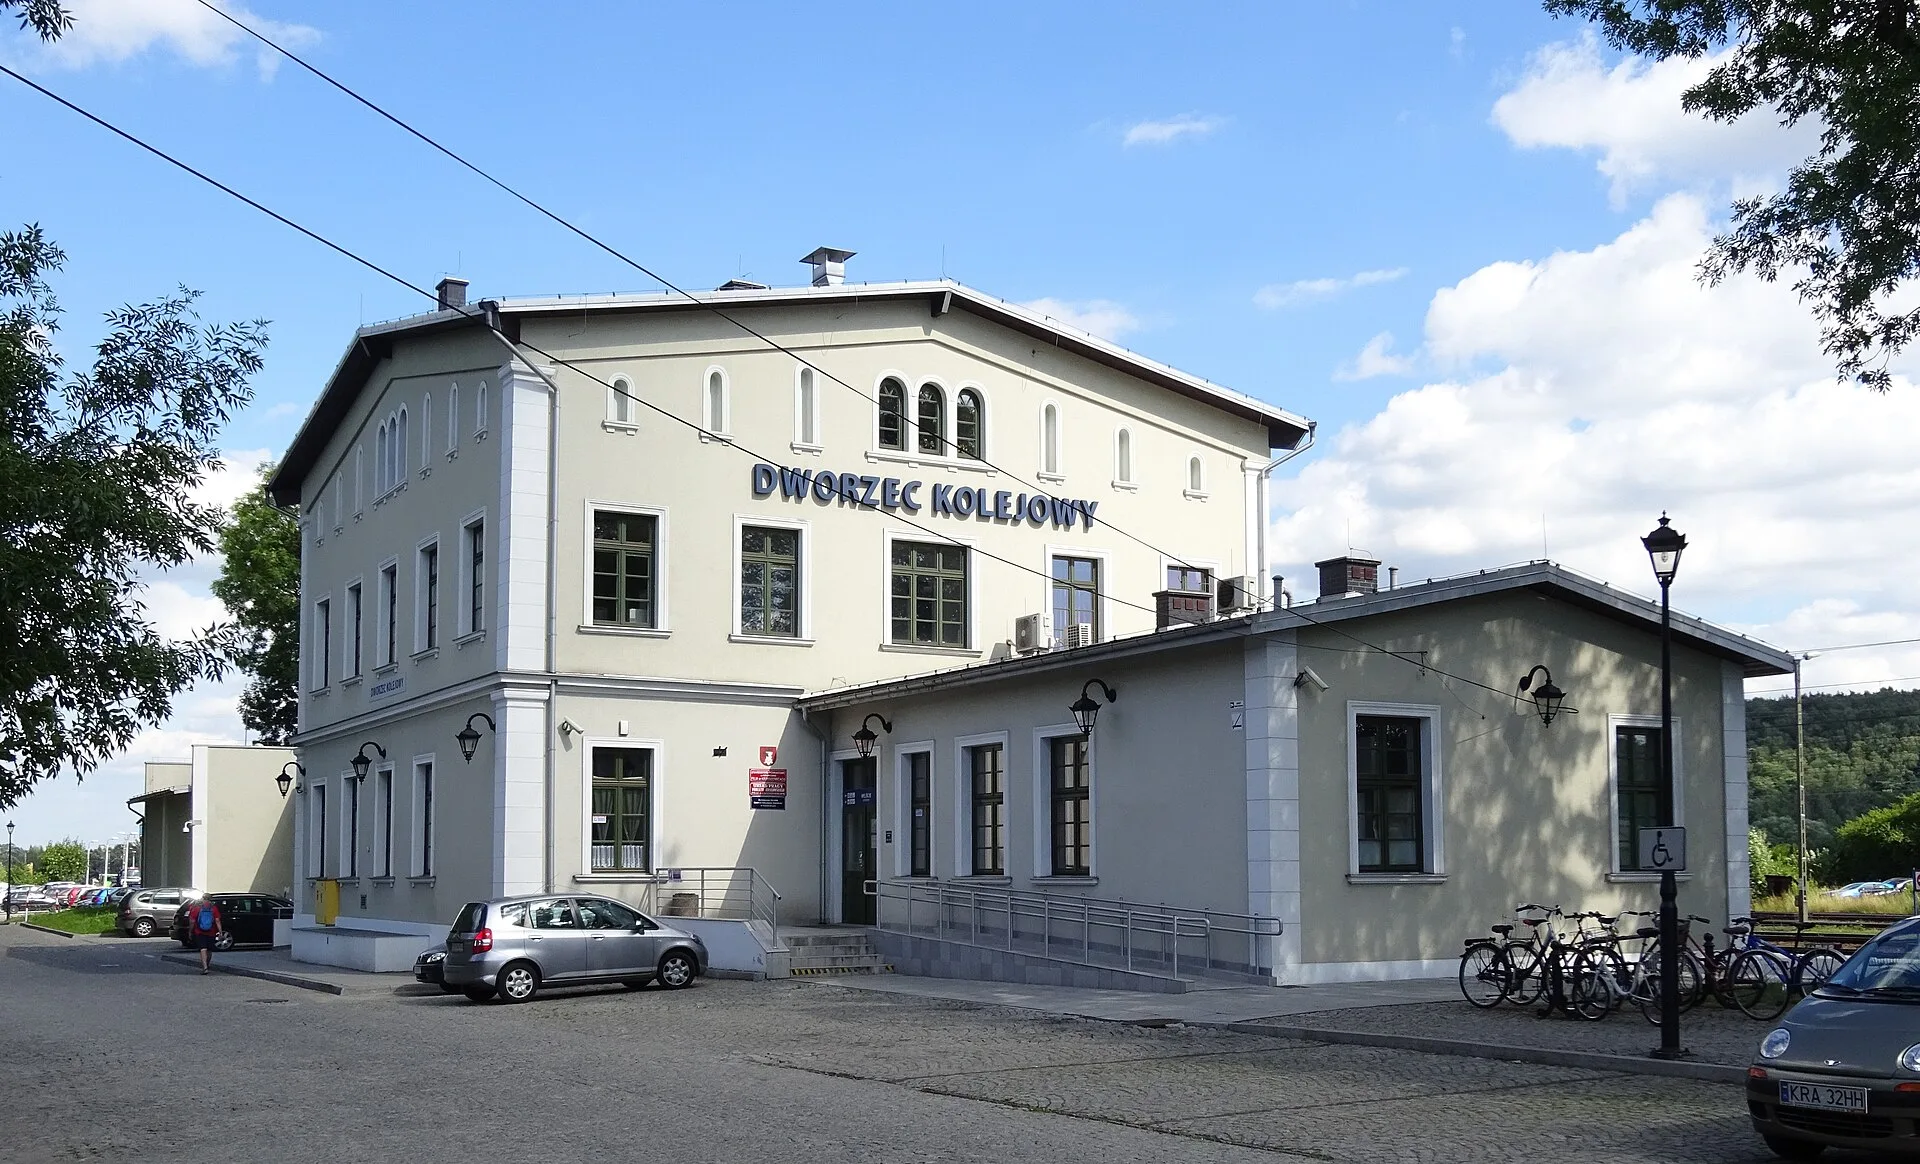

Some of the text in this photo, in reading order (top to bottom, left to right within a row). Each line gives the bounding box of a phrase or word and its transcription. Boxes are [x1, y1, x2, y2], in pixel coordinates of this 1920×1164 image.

[752, 463, 1099, 529] DWORZEC KOLEJOWY
[1790, 1084, 1864, 1108] KRA 32HH
